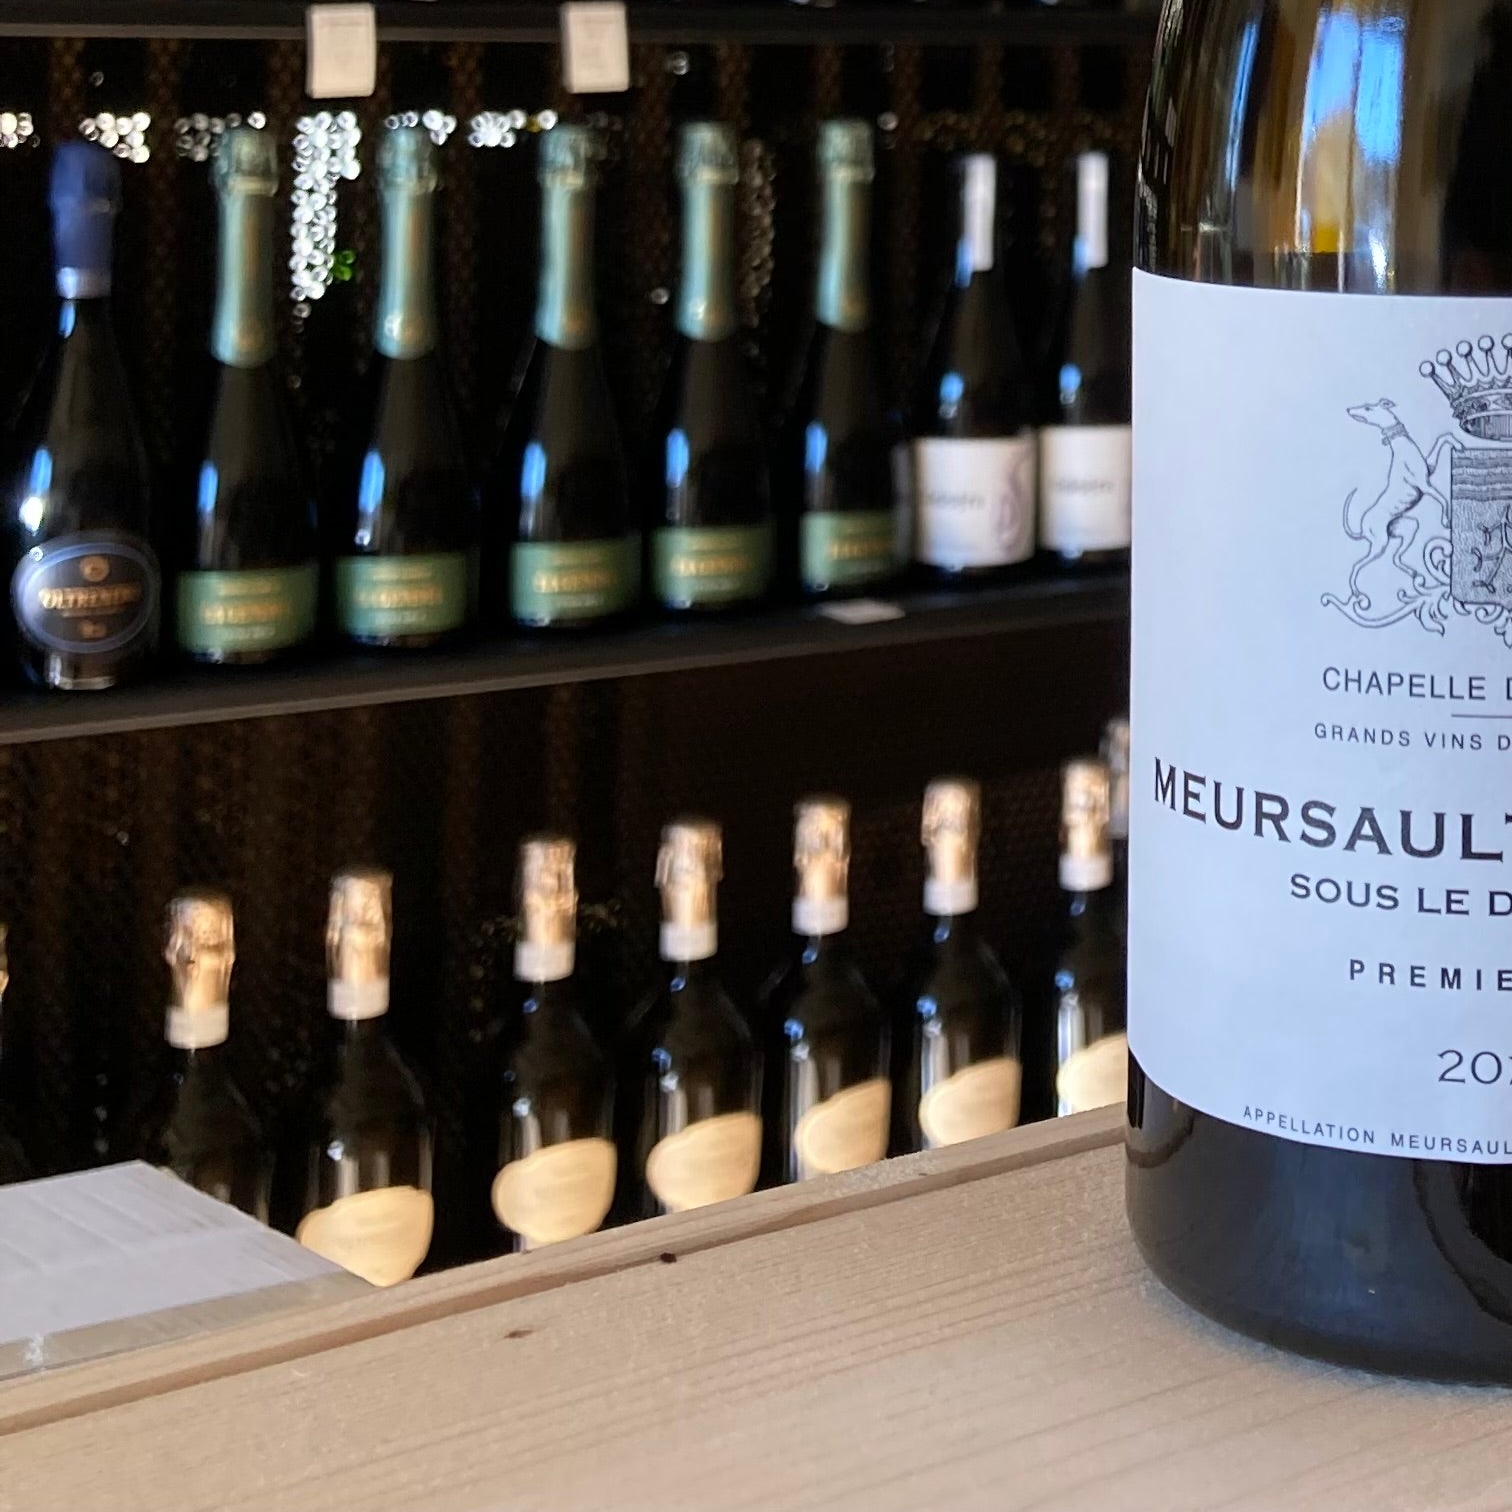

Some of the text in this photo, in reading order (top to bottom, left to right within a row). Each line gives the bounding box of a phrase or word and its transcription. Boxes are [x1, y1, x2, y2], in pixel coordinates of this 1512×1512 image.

[1322, 666, 1487, 702] CHAPELLE
[1314, 722, 1411, 748] GRANDS
[1423, 731, 1483, 751] VINS
[1289, 872, 1400, 912] SOUS
[1417, 886, 1471, 917] LE
[1242, 1104, 1376, 1145] APPELLATION
